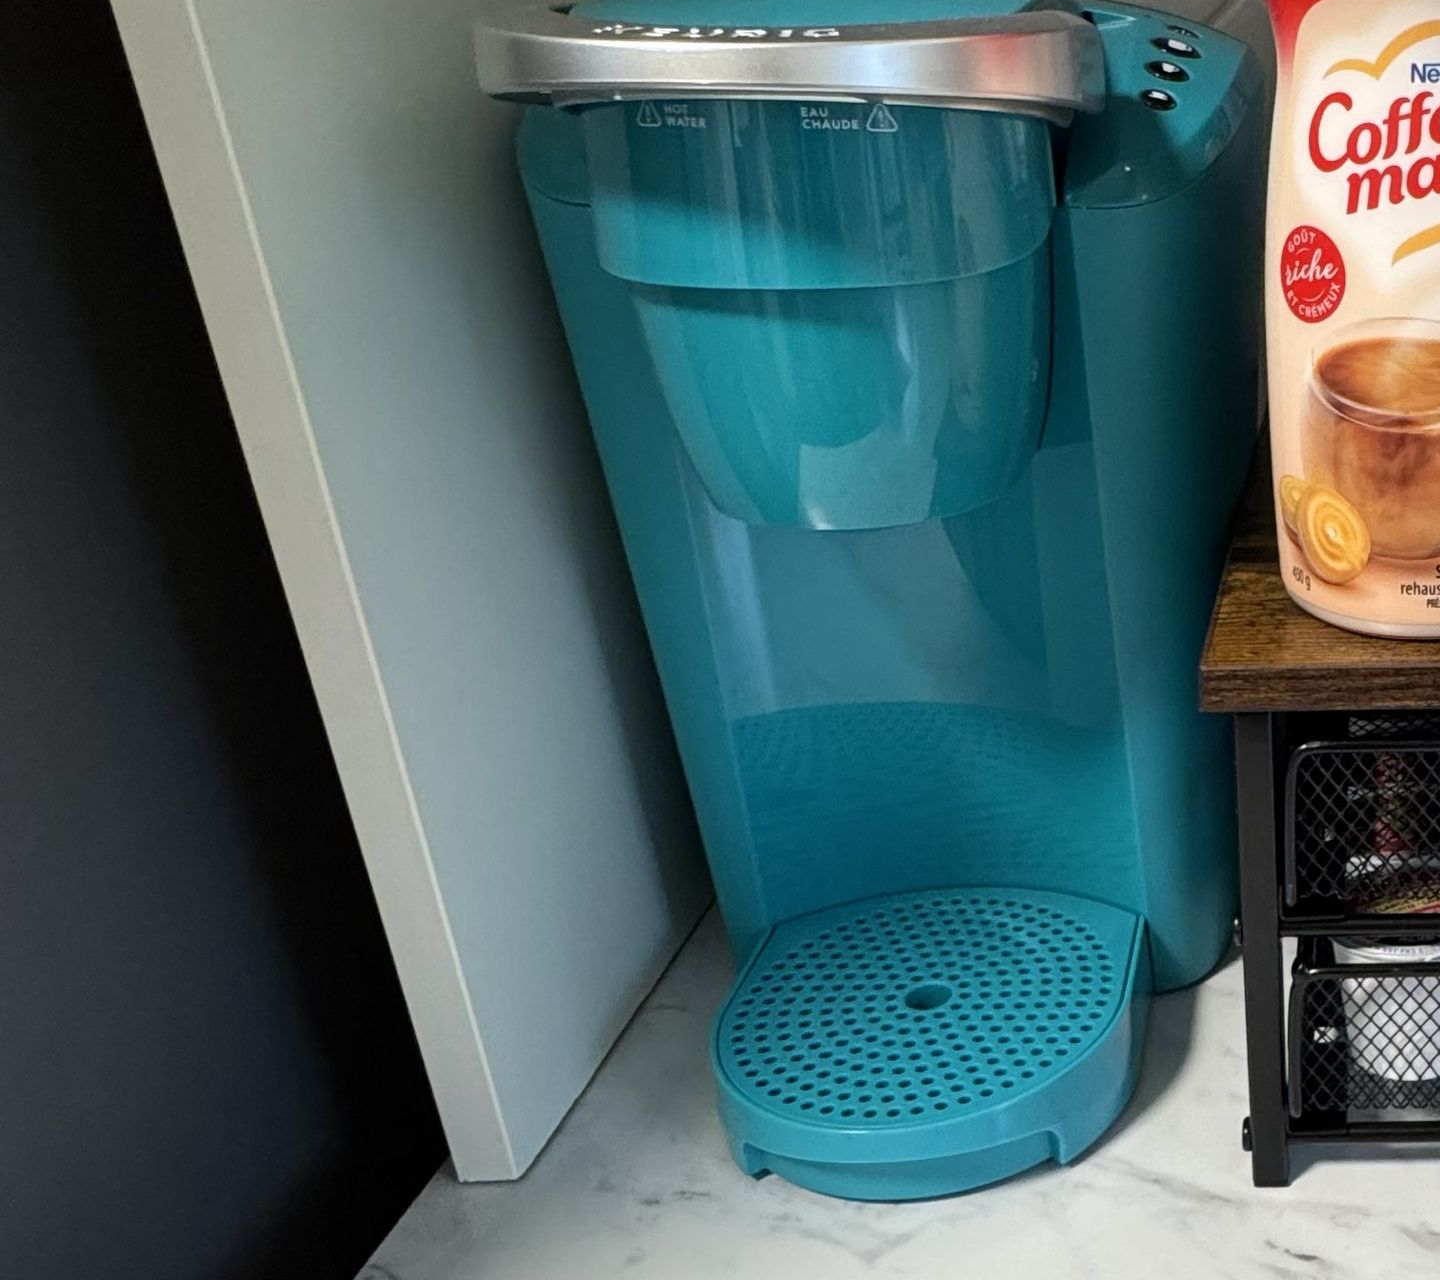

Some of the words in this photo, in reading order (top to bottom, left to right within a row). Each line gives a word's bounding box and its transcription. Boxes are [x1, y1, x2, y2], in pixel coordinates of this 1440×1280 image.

[664, 104, 688, 114] HOT
[801, 107, 828, 117] EAU
[665, 116, 706, 128] WATER
[802, 119, 859, 130] CHAUDE
[1288, 228, 1316, 252] GOÛT
[1285, 248, 1339, 286] riche
[1287, 289, 1298, 306] ET
[1299, 282, 1341, 318] CRÉMEUX
[1305, 576, 1311, 591] g
